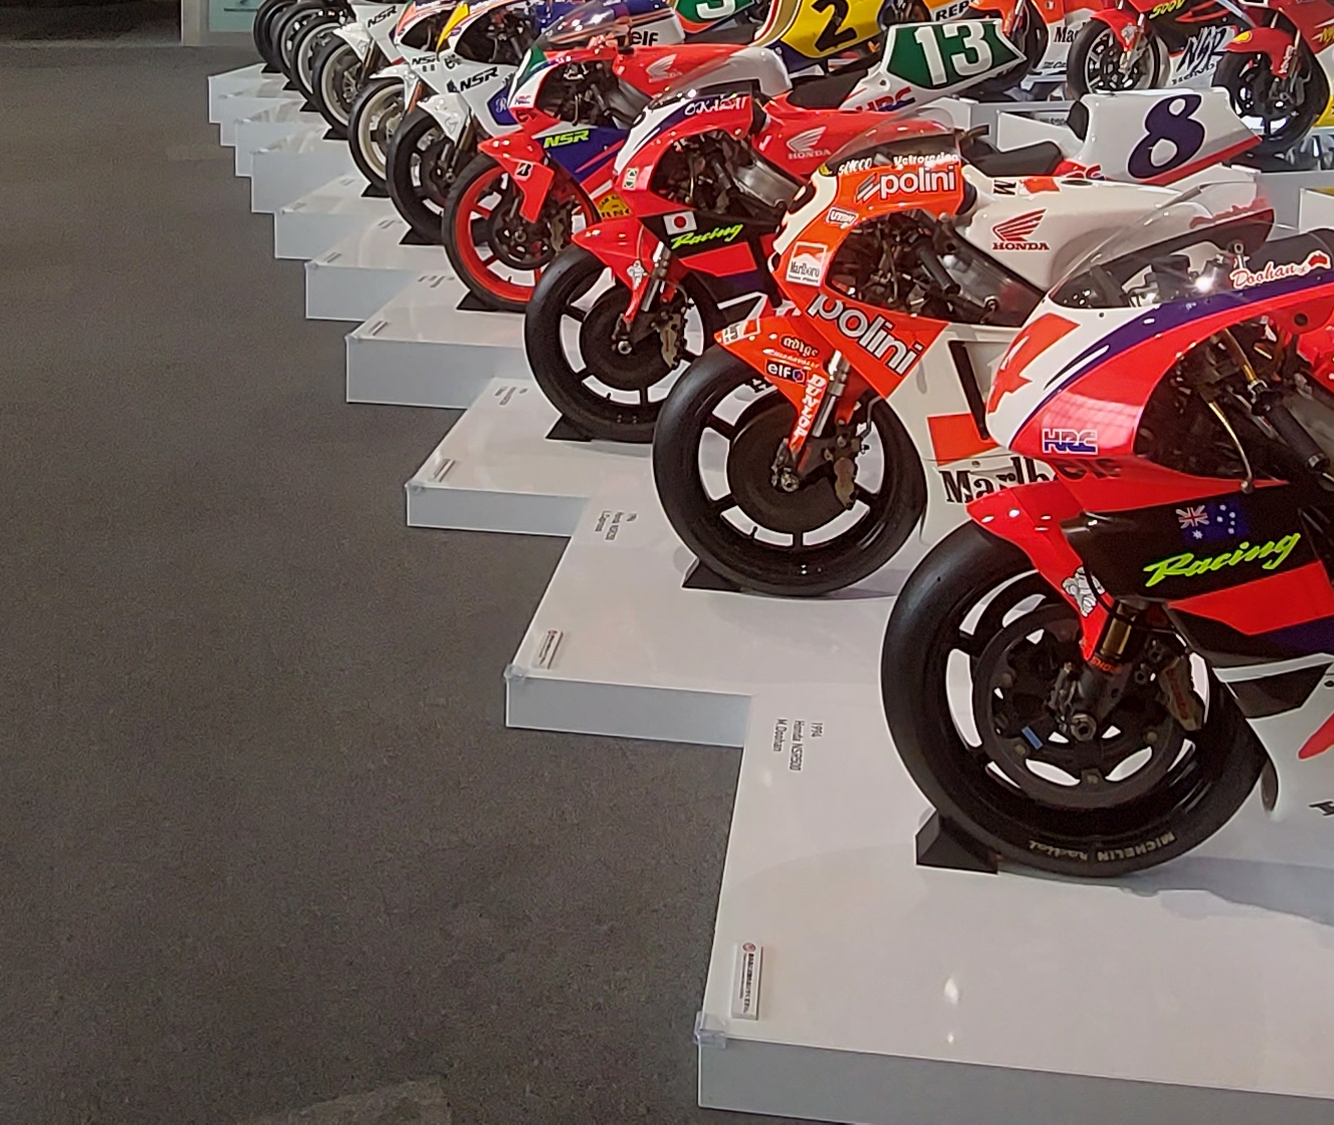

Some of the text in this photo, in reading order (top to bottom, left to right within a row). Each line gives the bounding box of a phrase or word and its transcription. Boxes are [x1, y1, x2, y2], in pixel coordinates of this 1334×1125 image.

[367, 5, 398, 29] NSR
[631, 30, 660, 46] elf
[915, 22, 993, 86] 13
[460, 67, 501, 93] NSR
[543, 129, 589, 149] NSR
[1128, 94, 1205, 179] 8
[788, 149, 832, 160] HONDA
[880, 165, 956, 200] polini
[671, 222, 745, 250] Racing
[992, 241, 1050, 252] HONDA
[790, 261, 820, 277] Marlboro
[1228, 262, 1297, 290] Doohan
[807, 294, 923, 377] polini
[767, 363, 792, 379] elf
[989, 313, 1080, 412] 4
[793, 373, 827, 440] DUNLOP
[1042, 428, 1099, 455] HRC
[1143, 532, 1301, 588] Racing
[773, 718, 788, 752] M.Doohan
[811, 722, 824, 738] 1994
[788, 720, 805, 772] Honda NSR500
[1097, 831, 1176, 862] MICHELIN
